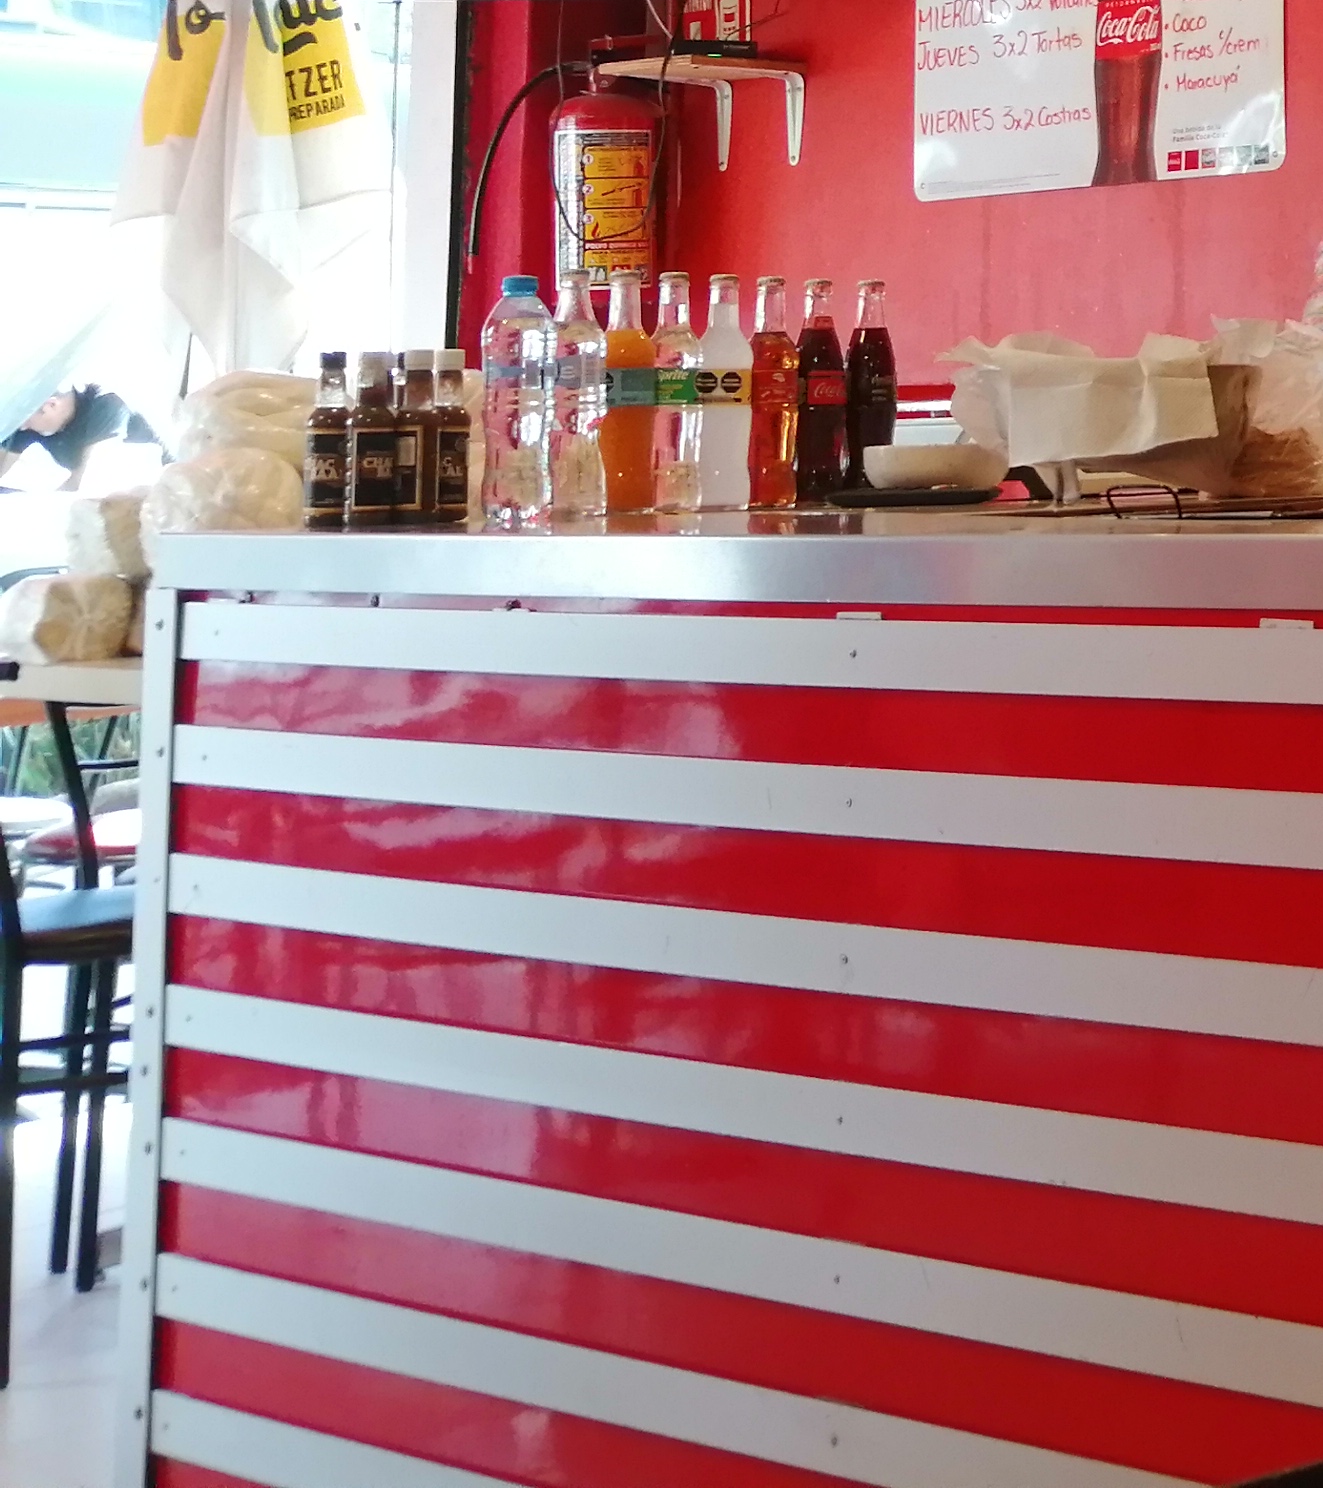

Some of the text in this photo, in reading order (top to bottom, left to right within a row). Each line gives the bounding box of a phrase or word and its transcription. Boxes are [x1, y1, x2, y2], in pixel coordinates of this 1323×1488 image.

[1097, 5, 1160, 46] Coca-Cola
[917, 40, 980, 71] JUEVES
[1031, 26, 1082, 55] Tortas
[285, 60, 343, 103] TZER
[920, 107, 994, 136] VIERNES
